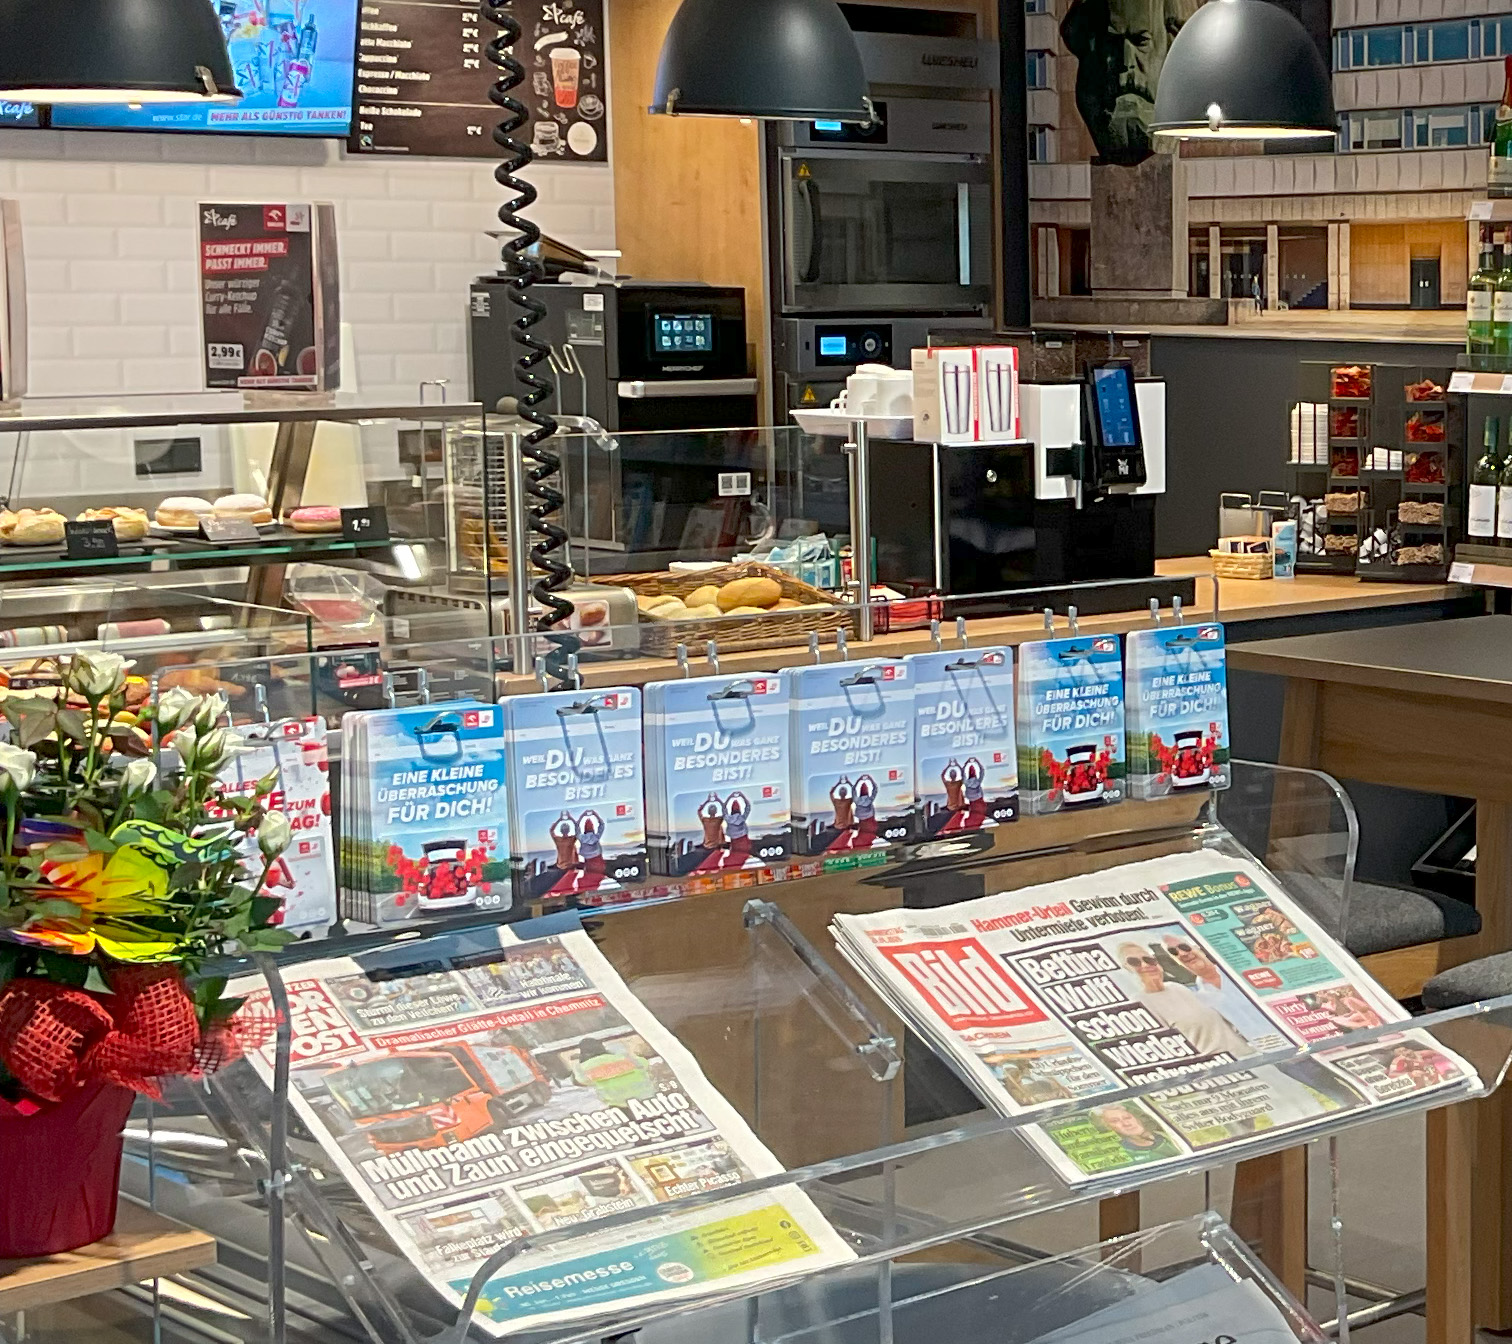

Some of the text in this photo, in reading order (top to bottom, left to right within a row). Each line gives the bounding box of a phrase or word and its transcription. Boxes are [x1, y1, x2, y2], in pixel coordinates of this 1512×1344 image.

[211, 110, 239, 121] MEHR
[241, 110, 260, 121] ALS
[306, 110, 347, 120] TANKEN!
[205, 242, 287, 256] SCHMECKT IMMER.
[205, 257, 268, 270] PASST IMMER.
[1152, 671, 1212, 687] EINE KLEINE
[1046, 684, 1110, 701] EINE KLEINE
[1142, 683, 1221, 702] ÜBERRASCHUNG
[936, 700, 966, 721] DU
[1035, 696, 1119, 715] ÜBERRASCHUNG
[1149, 697, 1218, 719] FÜR DICH!
[828, 716, 862, 737] DU
[1042, 711, 1115, 733] FÜR DICH!
[671, 737, 694, 748] WEIL
[693, 732, 731, 753] DU
[753, 735, 780, 745] GANZ
[810, 731, 907, 754] BESONDERES
[522, 754, 546, 765] WEIL
[545, 747, 584, 770] DU
[674, 746, 781, 771] BESONDERES
[844, 750, 882, 765] BIST!
[392, 765, 484, 786] EINE KLEINE
[712, 765, 752, 782] BIST!
[377, 778, 499, 803] ÜBERRASCHUNG
[564, 784, 607, 801] BIST!
[288, 798, 316, 811] ZUM
[386, 796, 492, 824] FÜR DICH!
[1169, 886, 1206, 902] REWE
[1207, 882, 1239, 895] Bonus
[970, 902, 1073, 933] Hammer-Urteil
[1069, 896, 1119, 913] Gewinn
[1119, 888, 1159, 905] durch
[1010, 908, 1148, 942] Untermiete verboten!
[1018, 948, 1112, 984] Bettina
[1045, 976, 1118, 1014] Wulff
[1277, 1000, 1308, 1015] Dirty
[376, 1025, 457, 1047] Dramatischer
[546, 998, 601, 1017] Chemnitz
[1076, 1005, 1155, 1041] schon
[1101, 1031, 1190, 1067] wieder
[360, 1090, 691, 1183] Müllmann zwischen Auto
[387, 1109, 701, 1201] und Zaun eingequetscht
[664, 1180, 698, 1197] Echter
[580, 1198, 634, 1220] Grabstein
[435, 1234, 494, 1257] Falkeplatz
[495, 1226, 523, 1243] wird
[503, 1260, 635, 1299] Reisemesse
